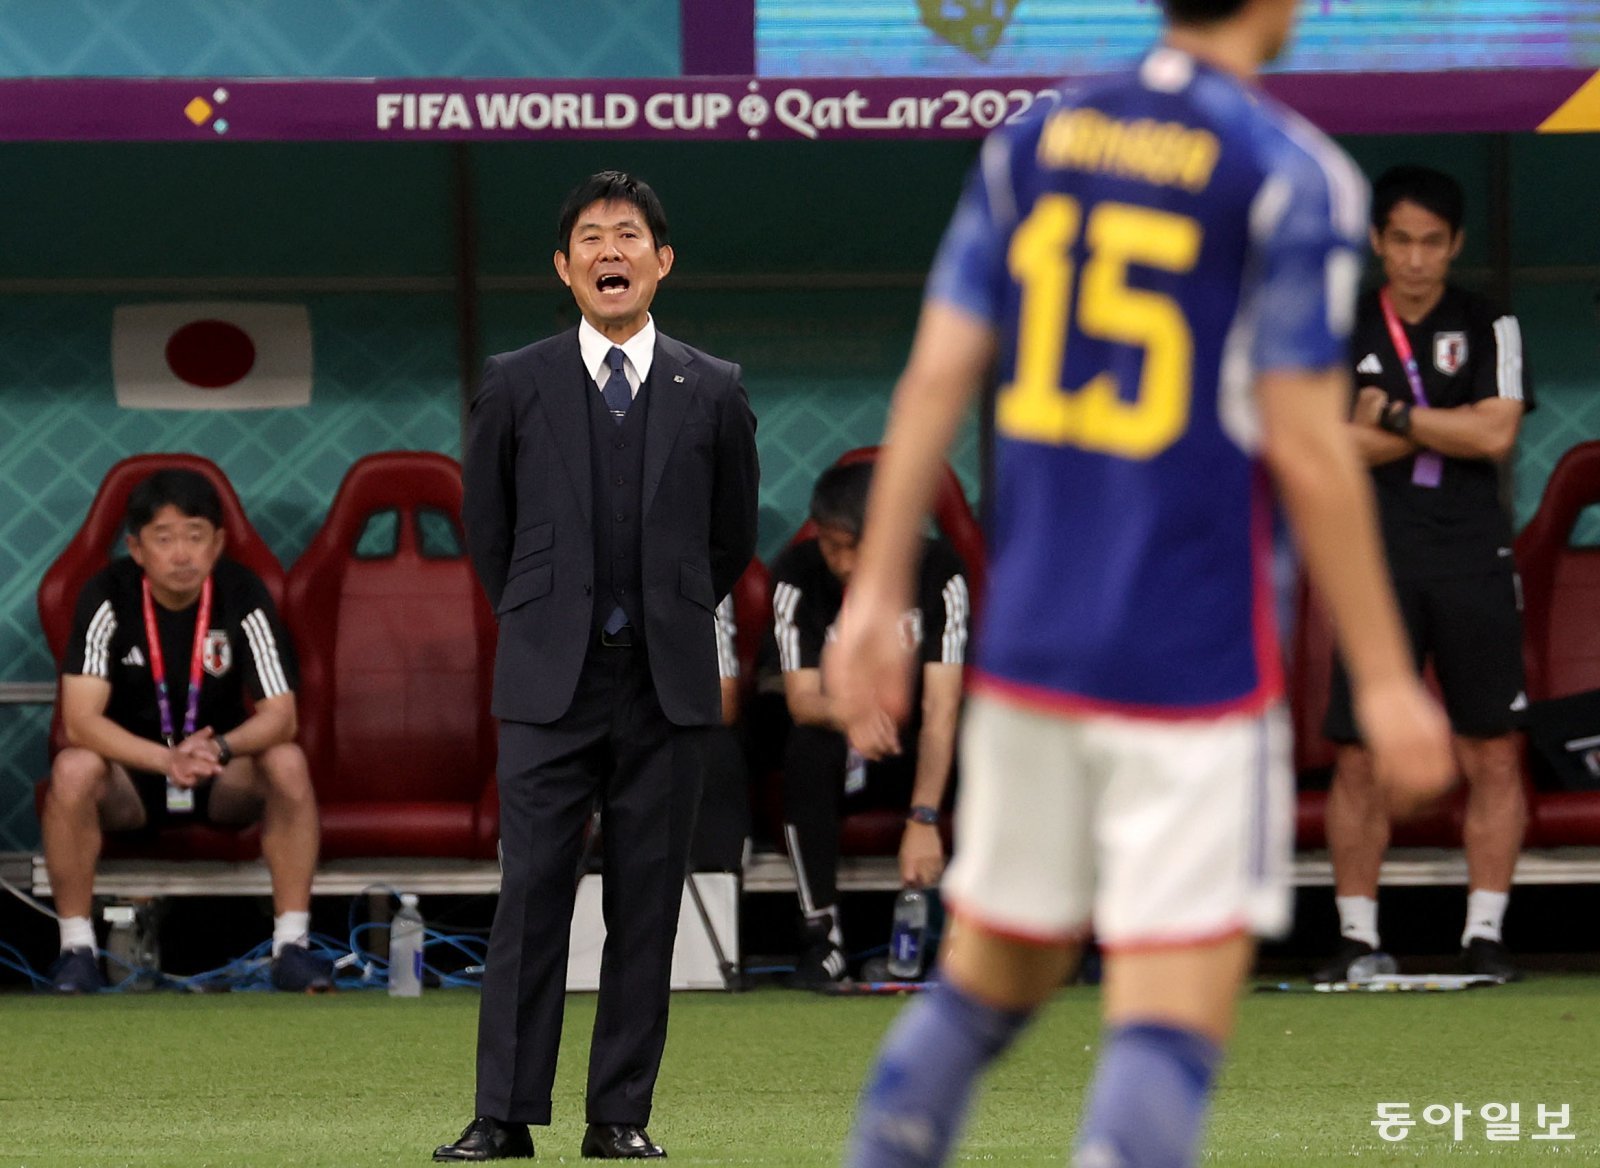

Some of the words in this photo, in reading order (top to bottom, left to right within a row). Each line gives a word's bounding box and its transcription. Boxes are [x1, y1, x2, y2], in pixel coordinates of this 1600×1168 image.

[376, 93, 472, 129] FIFA
[475, 93, 637, 129] WORLD
[643, 93, 732, 129] CUP
[997, 194, 1202, 459] 15
